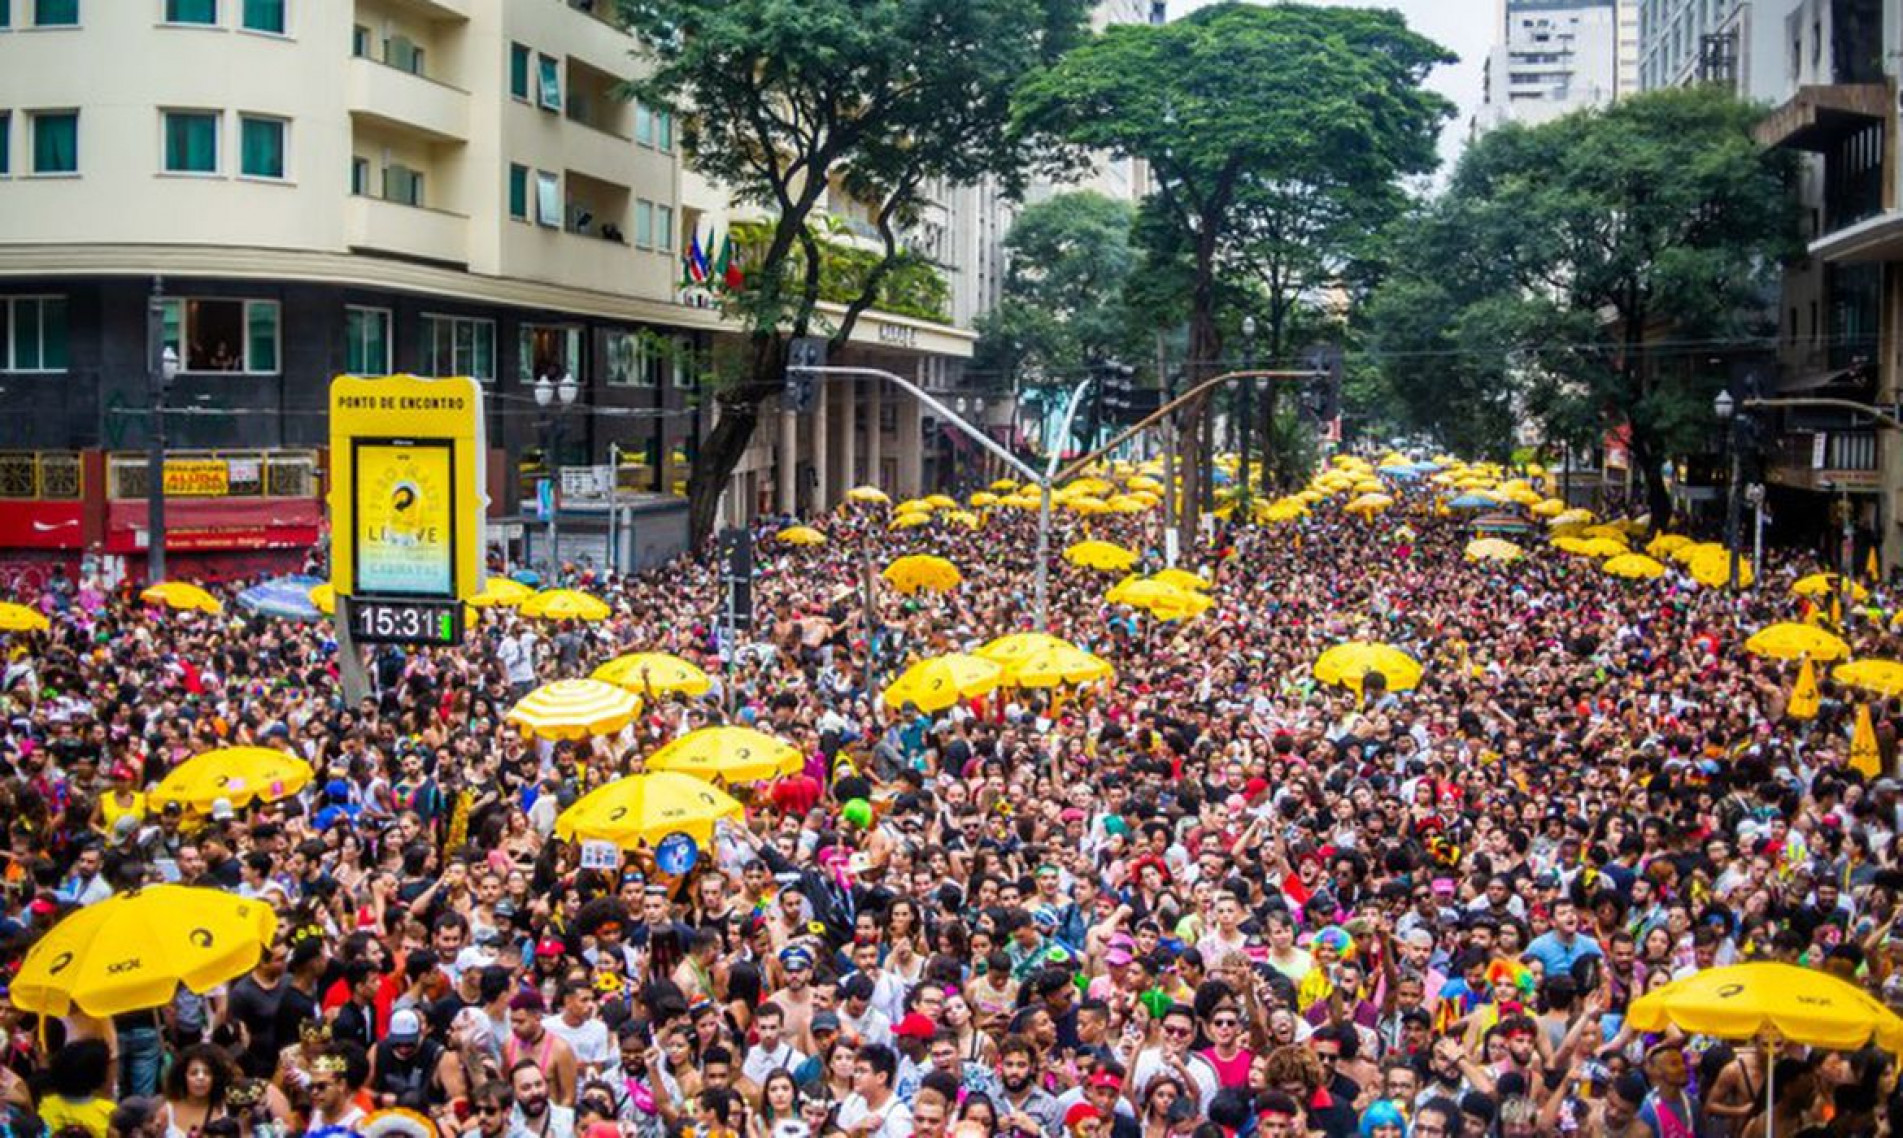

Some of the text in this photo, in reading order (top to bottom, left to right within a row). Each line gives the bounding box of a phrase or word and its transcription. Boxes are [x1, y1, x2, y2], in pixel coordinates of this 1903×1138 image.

[338, 396, 465, 411] PONTO DE ENCONTRO
[360, 606, 434, 638] 15:31
